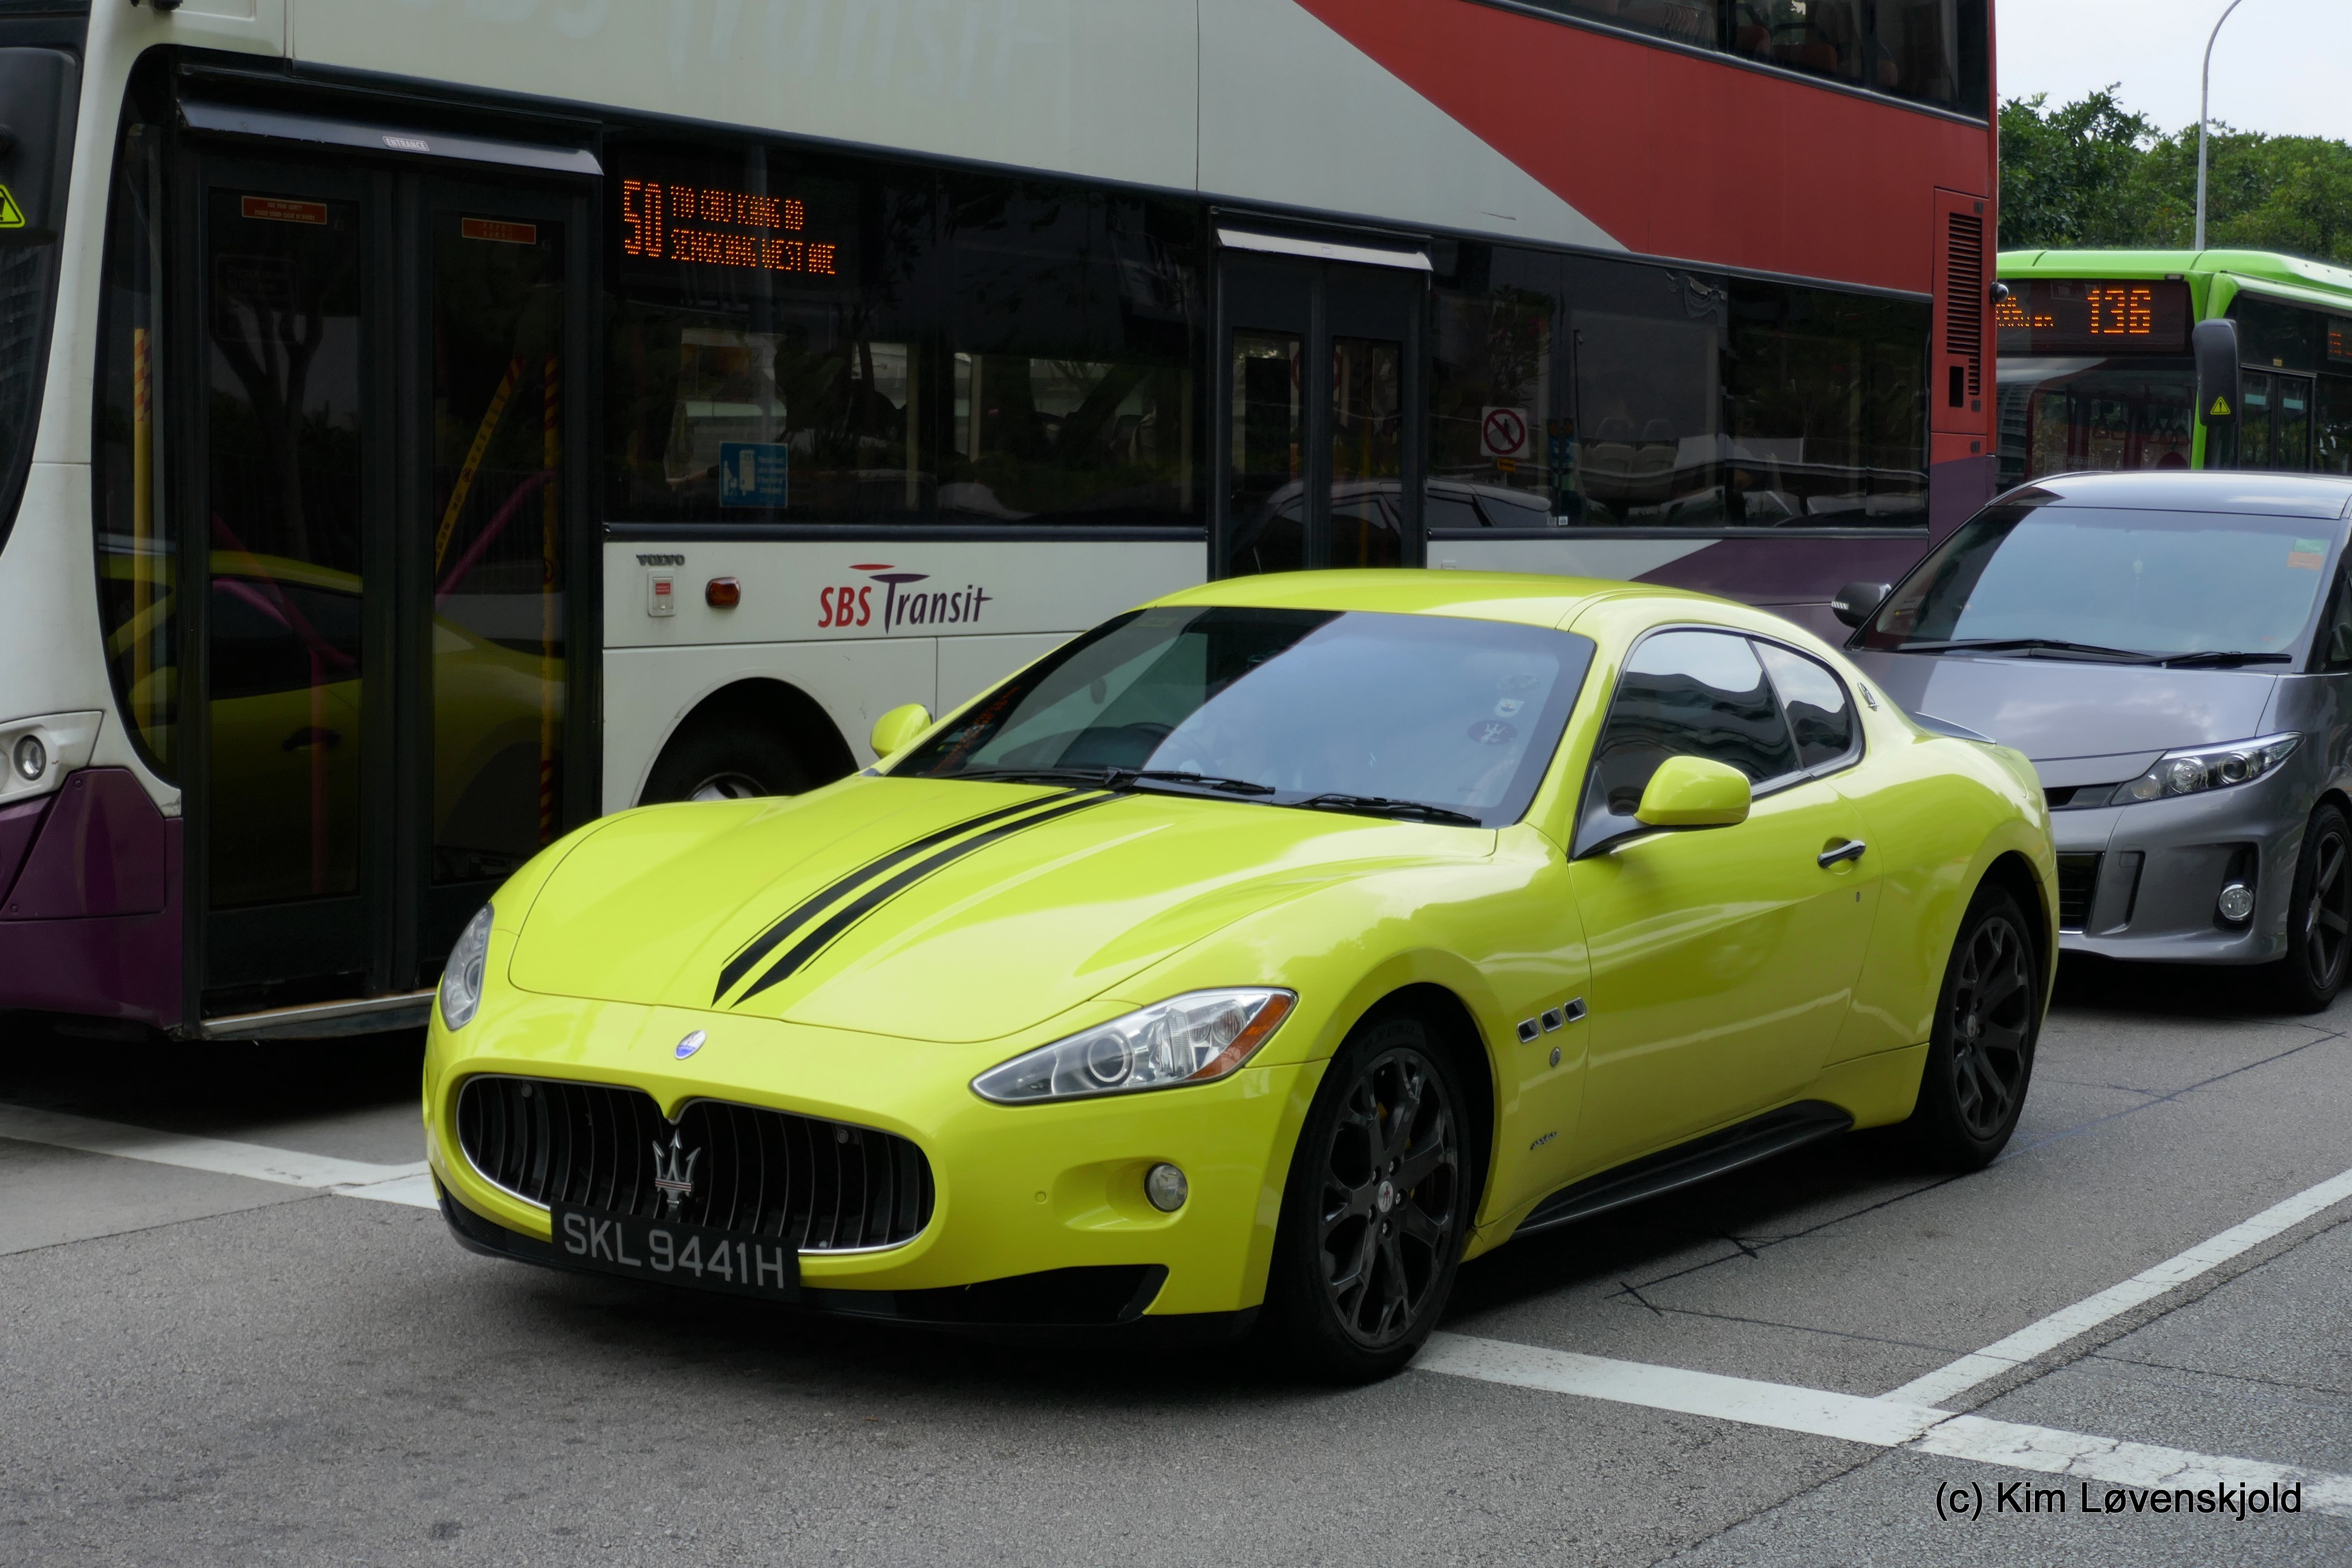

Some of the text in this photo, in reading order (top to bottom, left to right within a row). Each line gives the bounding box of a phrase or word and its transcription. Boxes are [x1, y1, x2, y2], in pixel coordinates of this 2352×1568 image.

[385, 138, 426, 150] ENTRANCE
[624, 180, 662, 257] 50
[2087, 289, 2151, 334] 136
[636, 554, 685, 566] VOLVO
[817, 572, 993, 635] SBS Transit
